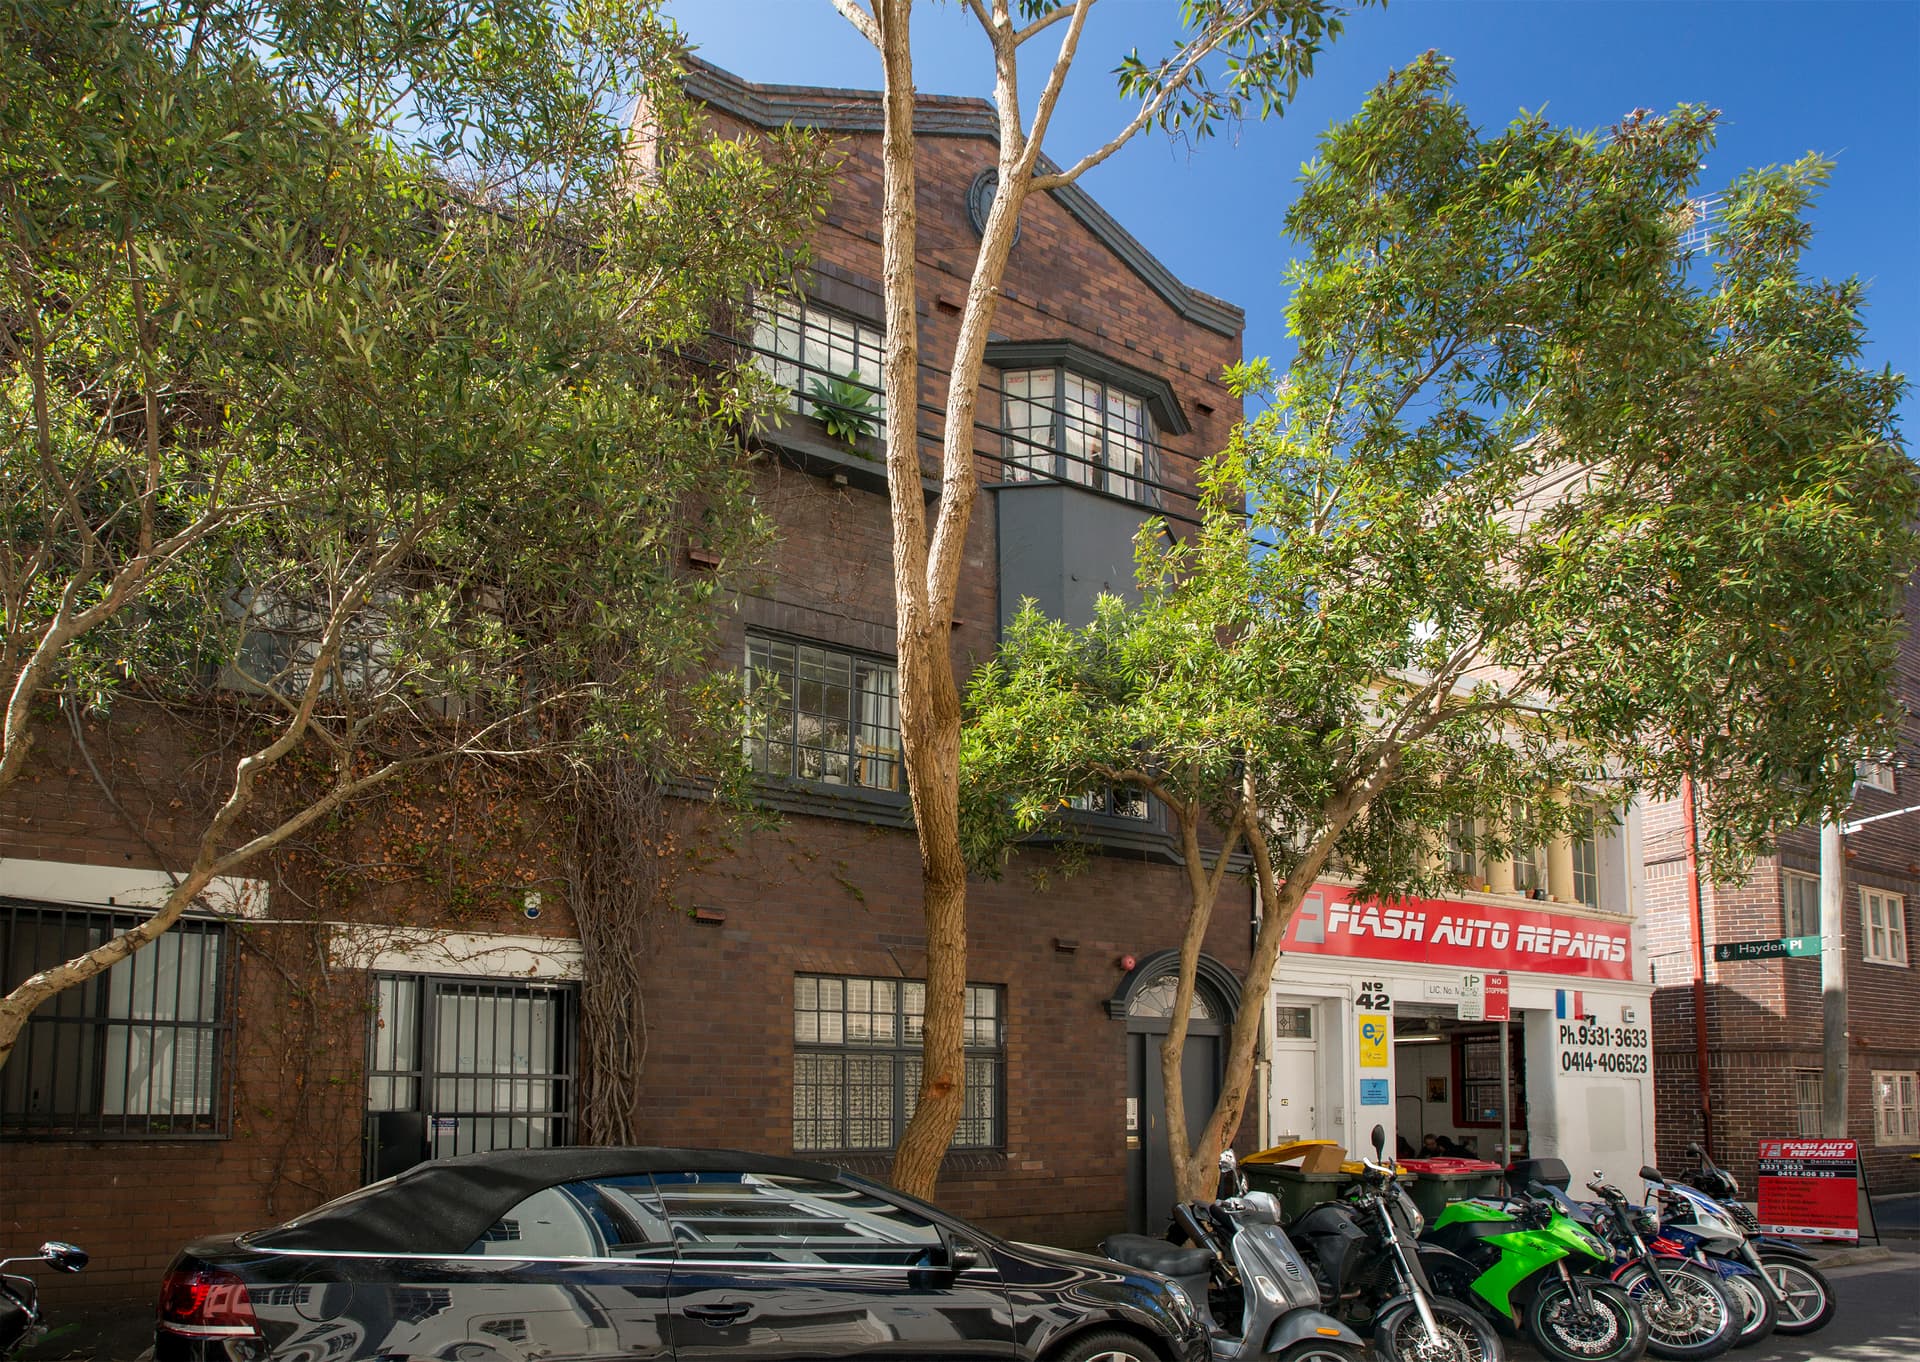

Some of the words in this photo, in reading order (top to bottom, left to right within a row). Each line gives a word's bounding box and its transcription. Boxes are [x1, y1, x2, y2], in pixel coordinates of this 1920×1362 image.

[1327, 902, 1426, 942] FLASH
[1429, 915, 1511, 951] AUTO
[1515, 925, 1627, 963] REPAIRS
[1738, 942, 1786, 955] Hayden
[1789, 939, 1803, 950] Pl
[1463, 974, 1480, 988] 1P
[1485, 987, 1509, 995] STOPPING
[1355, 993, 1391, 1011] 42
